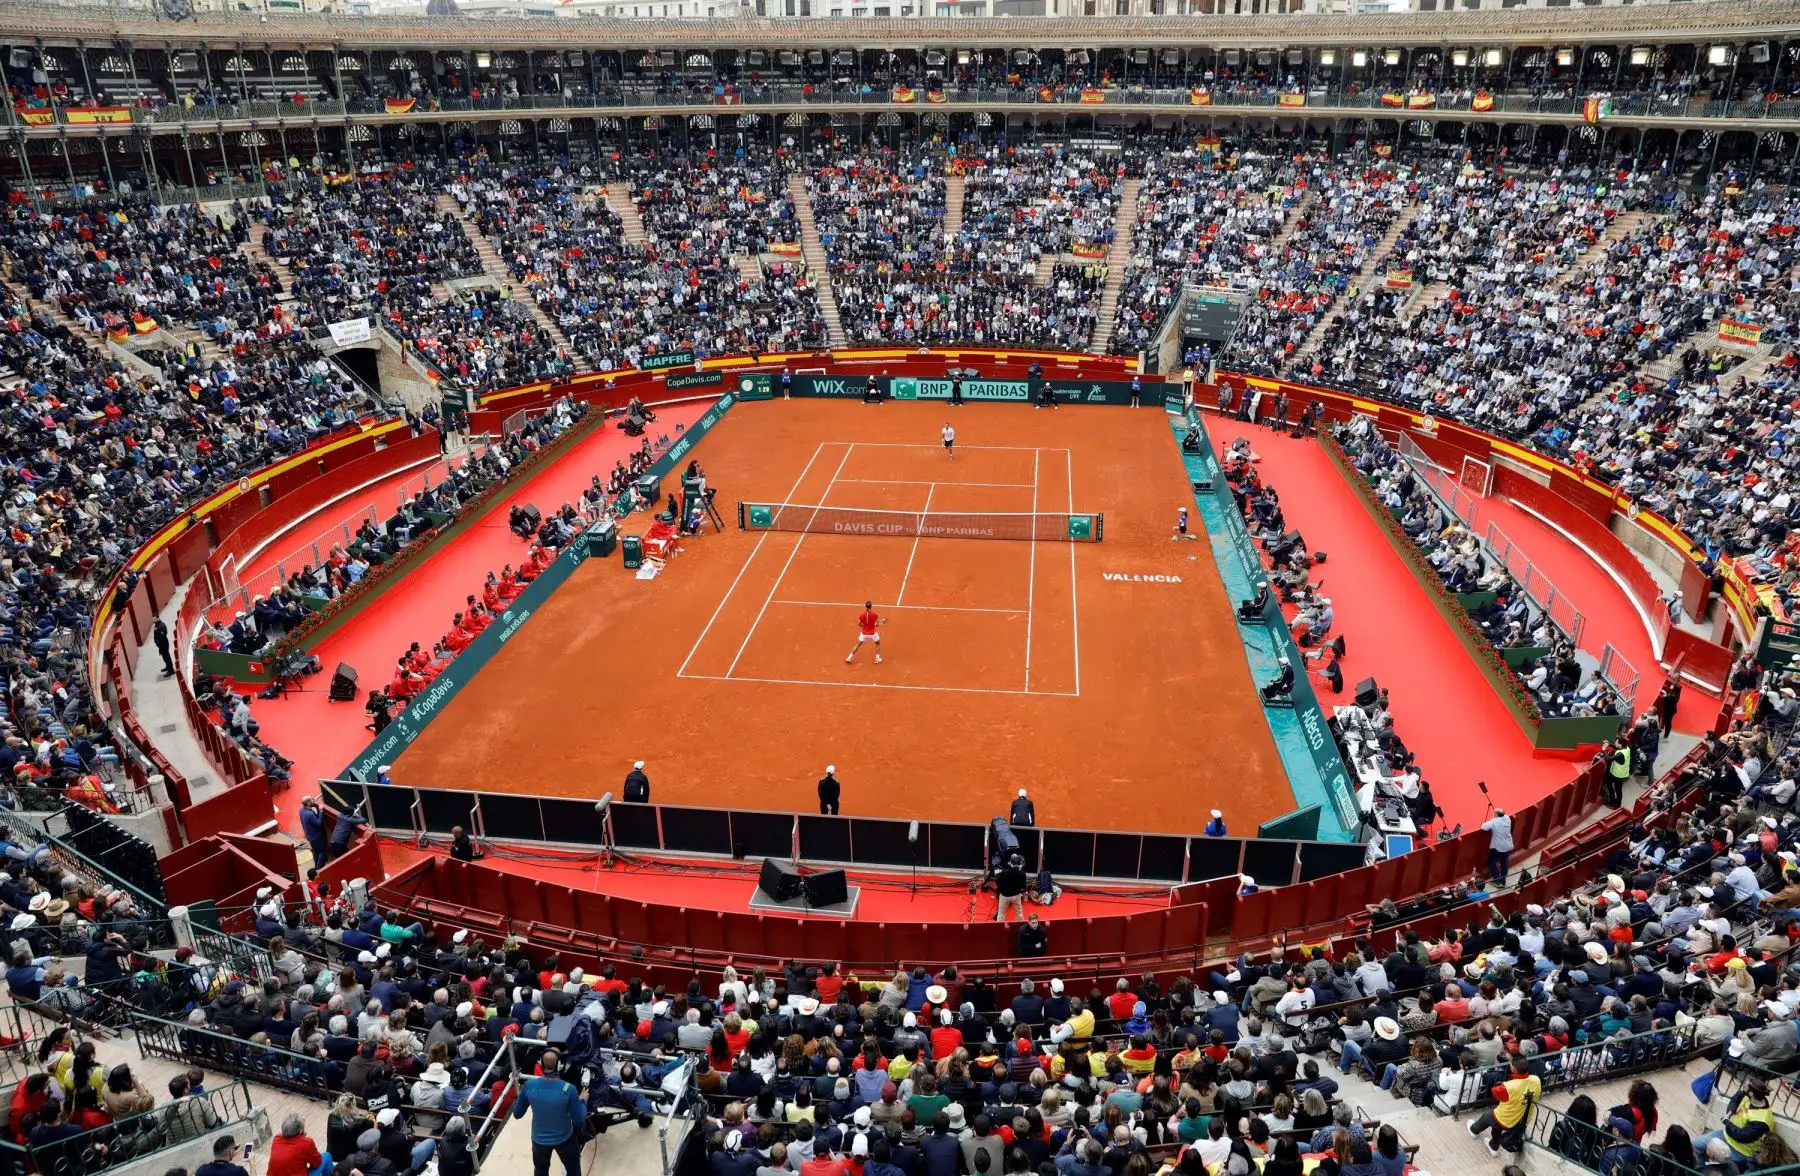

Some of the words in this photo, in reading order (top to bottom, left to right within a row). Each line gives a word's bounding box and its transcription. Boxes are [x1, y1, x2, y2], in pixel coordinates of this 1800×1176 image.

[643, 354, 691, 367] MAPFRE
[667, 375, 721, 387] CopaDavis.com
[920, 383, 948, 395] BNP
[969, 384, 1026, 397] PARIBAS
[1166, 396, 1183, 404] Adecco
[669, 438, 690, 461] MAPFRE
[834, 522, 874, 533] DAVIS
[877, 524, 903, 533] CUP
[946, 527, 994, 536] PARIBAS
[411, 677, 454, 721] #CopaDavis
[1302, 706, 1324, 750] Adecco
[358, 735, 398, 778] paDavis.com
[1301, 1001, 1307, 1009] 5
